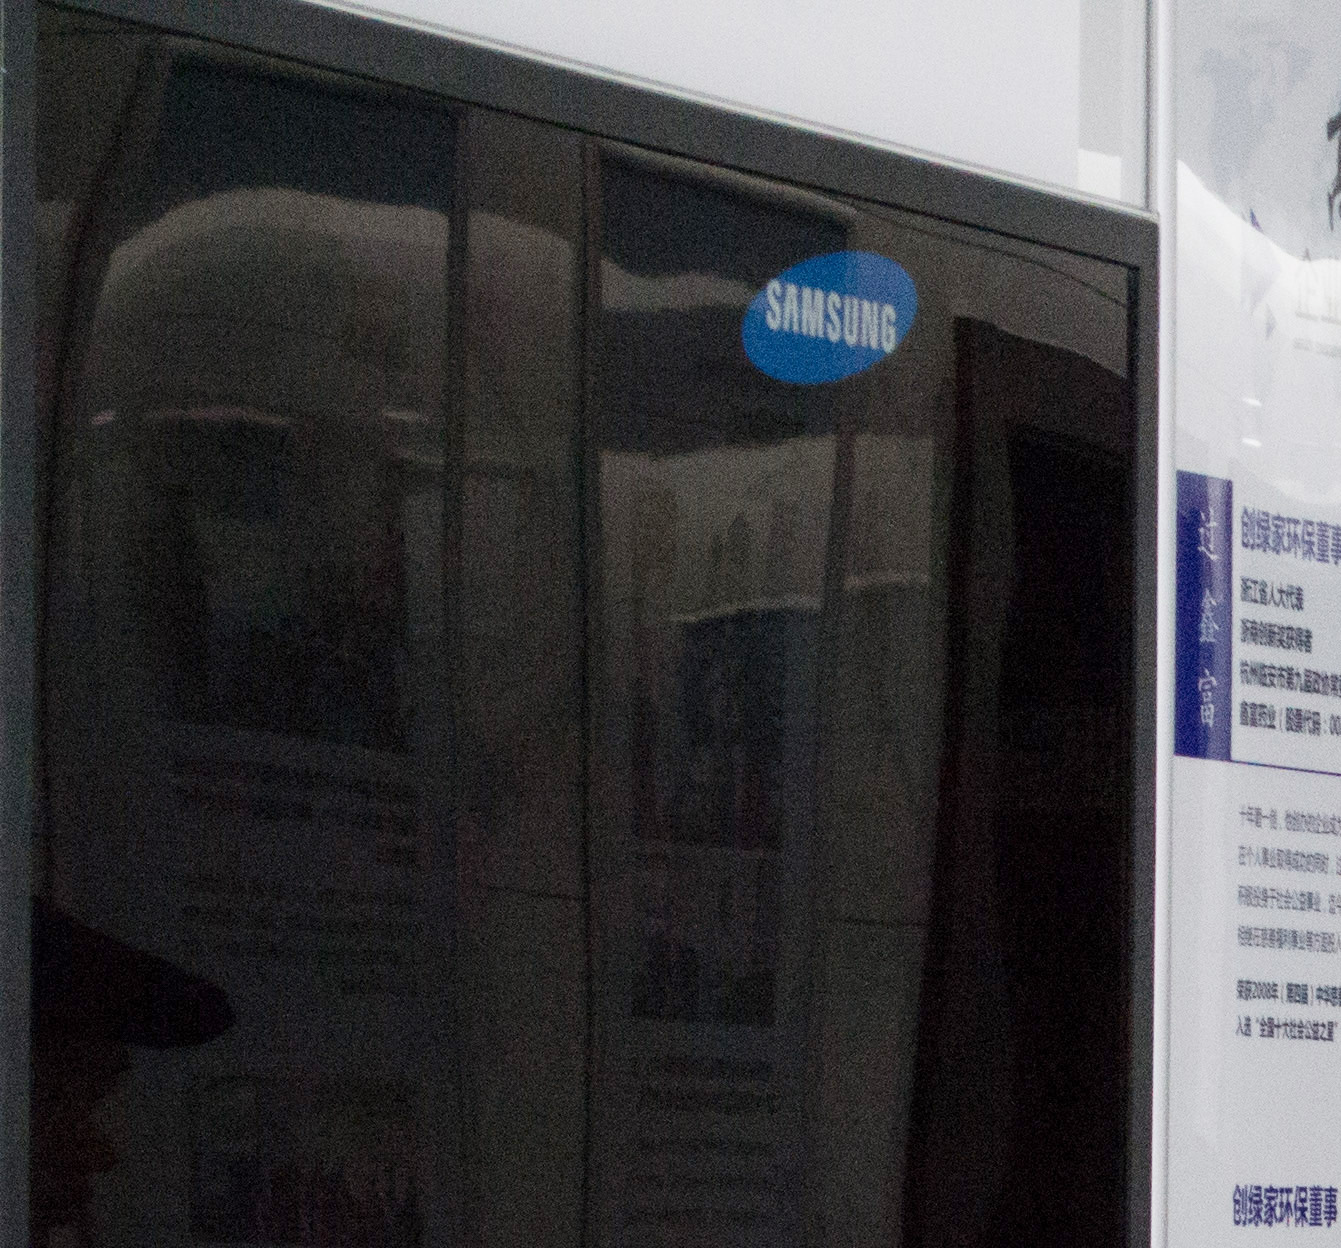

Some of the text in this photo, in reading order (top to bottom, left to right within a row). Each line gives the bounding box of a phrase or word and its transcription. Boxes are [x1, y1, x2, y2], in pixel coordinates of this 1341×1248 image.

[765, 279, 898, 355] SAMSUNG
[1232, 1183, 1338, 1228] 创绿家环保董事
